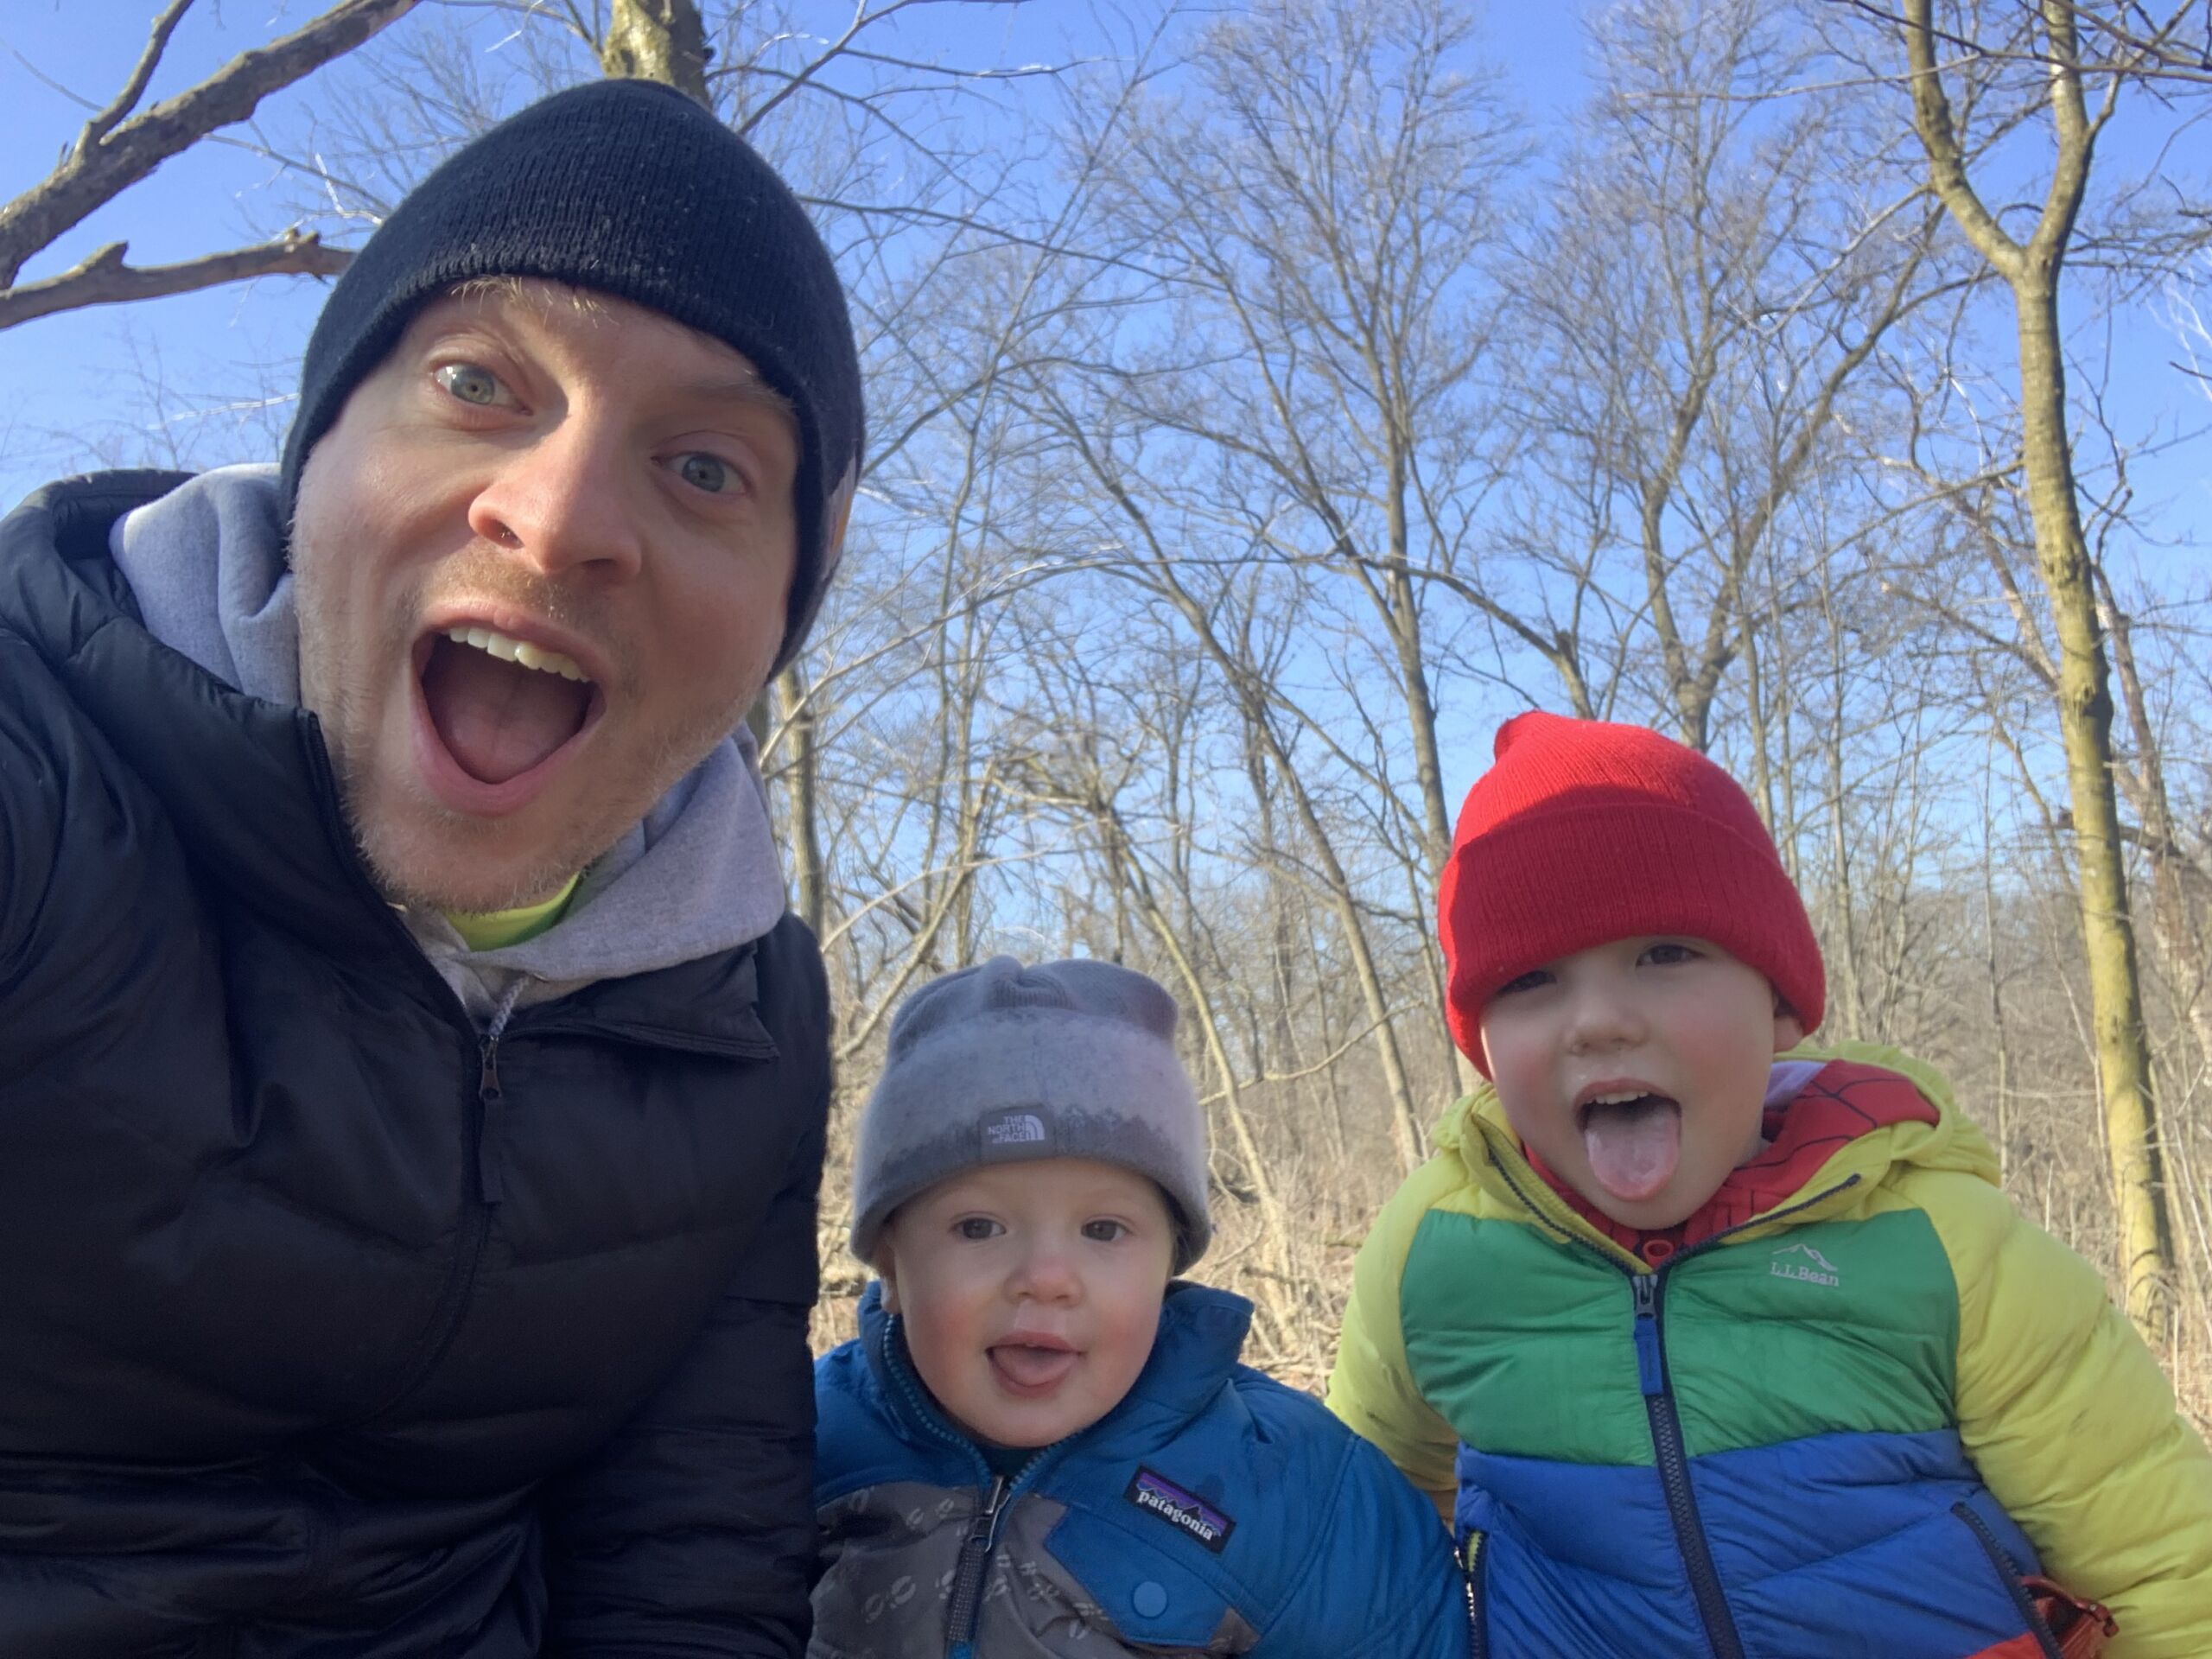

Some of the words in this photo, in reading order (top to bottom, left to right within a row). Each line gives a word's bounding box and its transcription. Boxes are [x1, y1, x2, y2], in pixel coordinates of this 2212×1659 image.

[1003, 1115, 1025, 1124] THE
[988, 1122, 1025, 1135] NORTH
[999, 1132, 1026, 1142] FACE
[1136, 1491, 1213, 1540] patagonia
